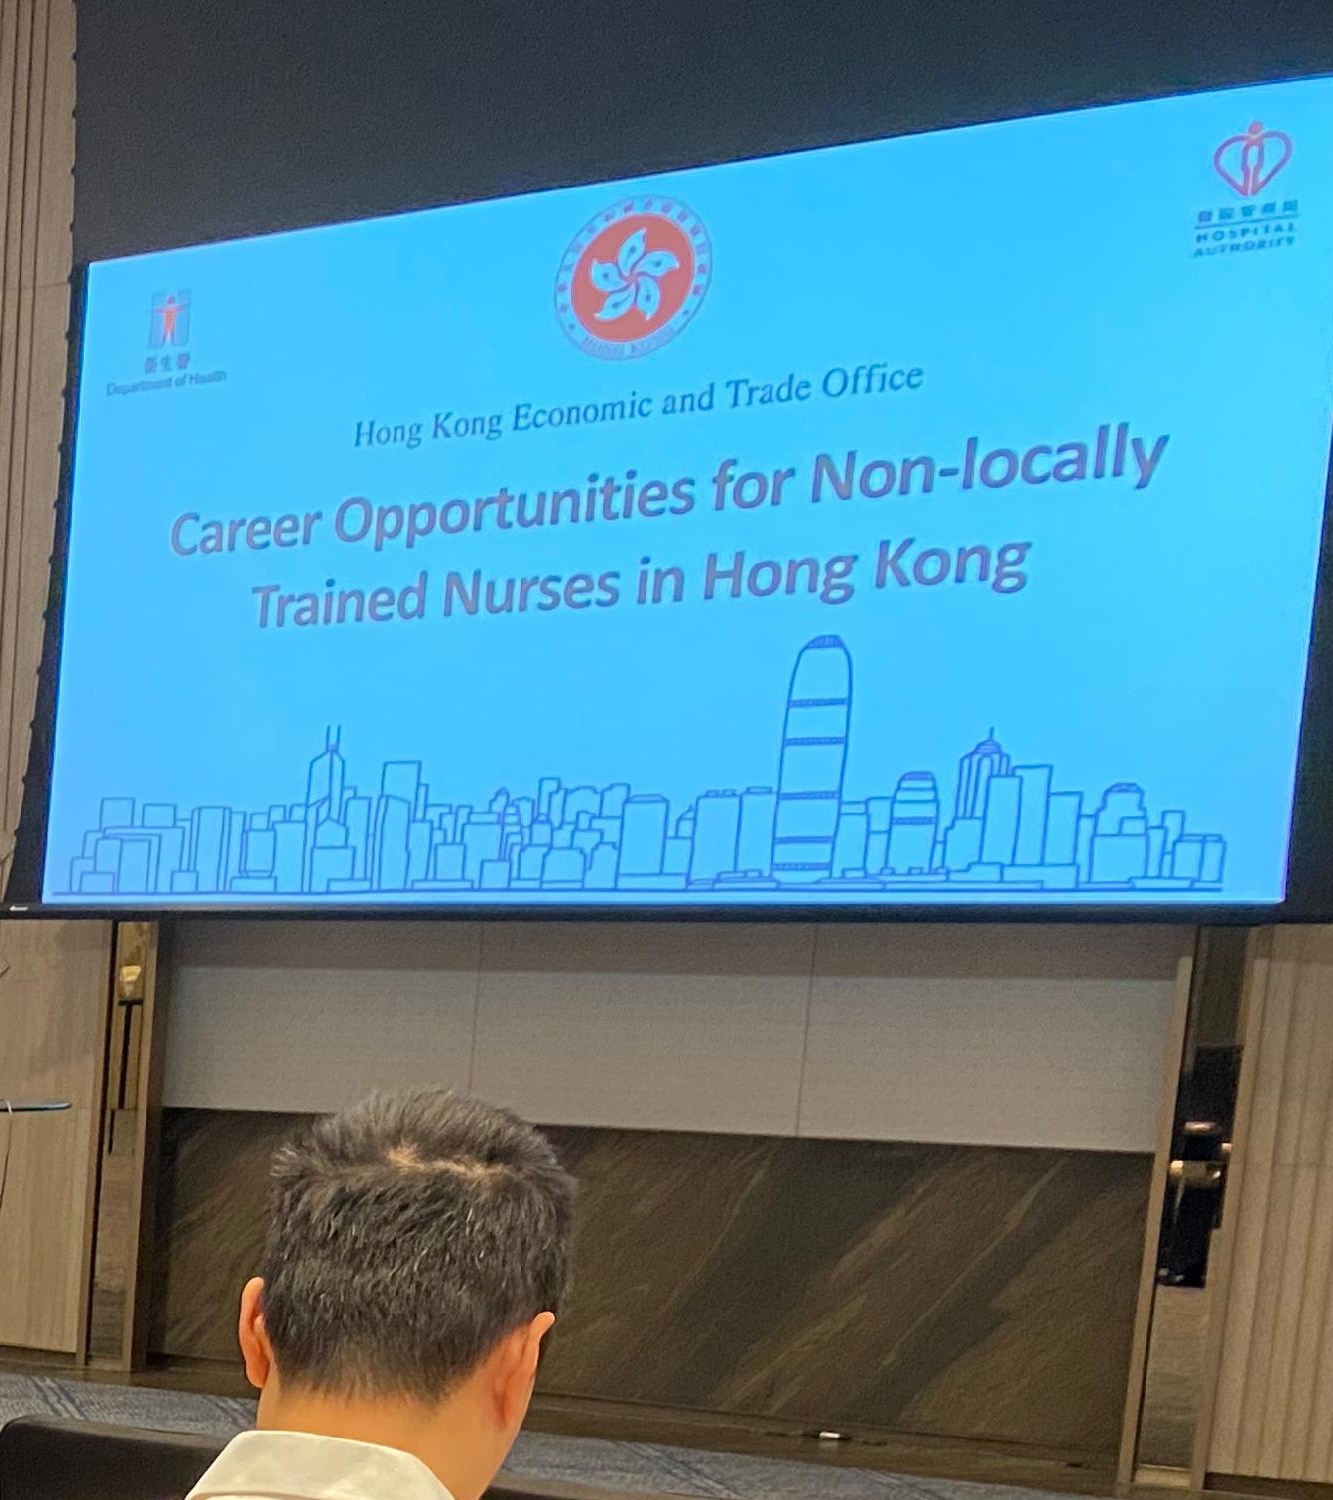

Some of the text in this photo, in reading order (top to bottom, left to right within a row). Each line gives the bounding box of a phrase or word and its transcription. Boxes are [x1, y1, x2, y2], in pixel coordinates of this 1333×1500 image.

[105, 370, 228, 396] Department of Health
[354, 363, 923, 449] Hong Kong Economic and Trade Office
[170, 422, 1170, 555] Career Opportunities for Non-locally
[251, 538, 1033, 629] Trained Nurses in Hong Kong
